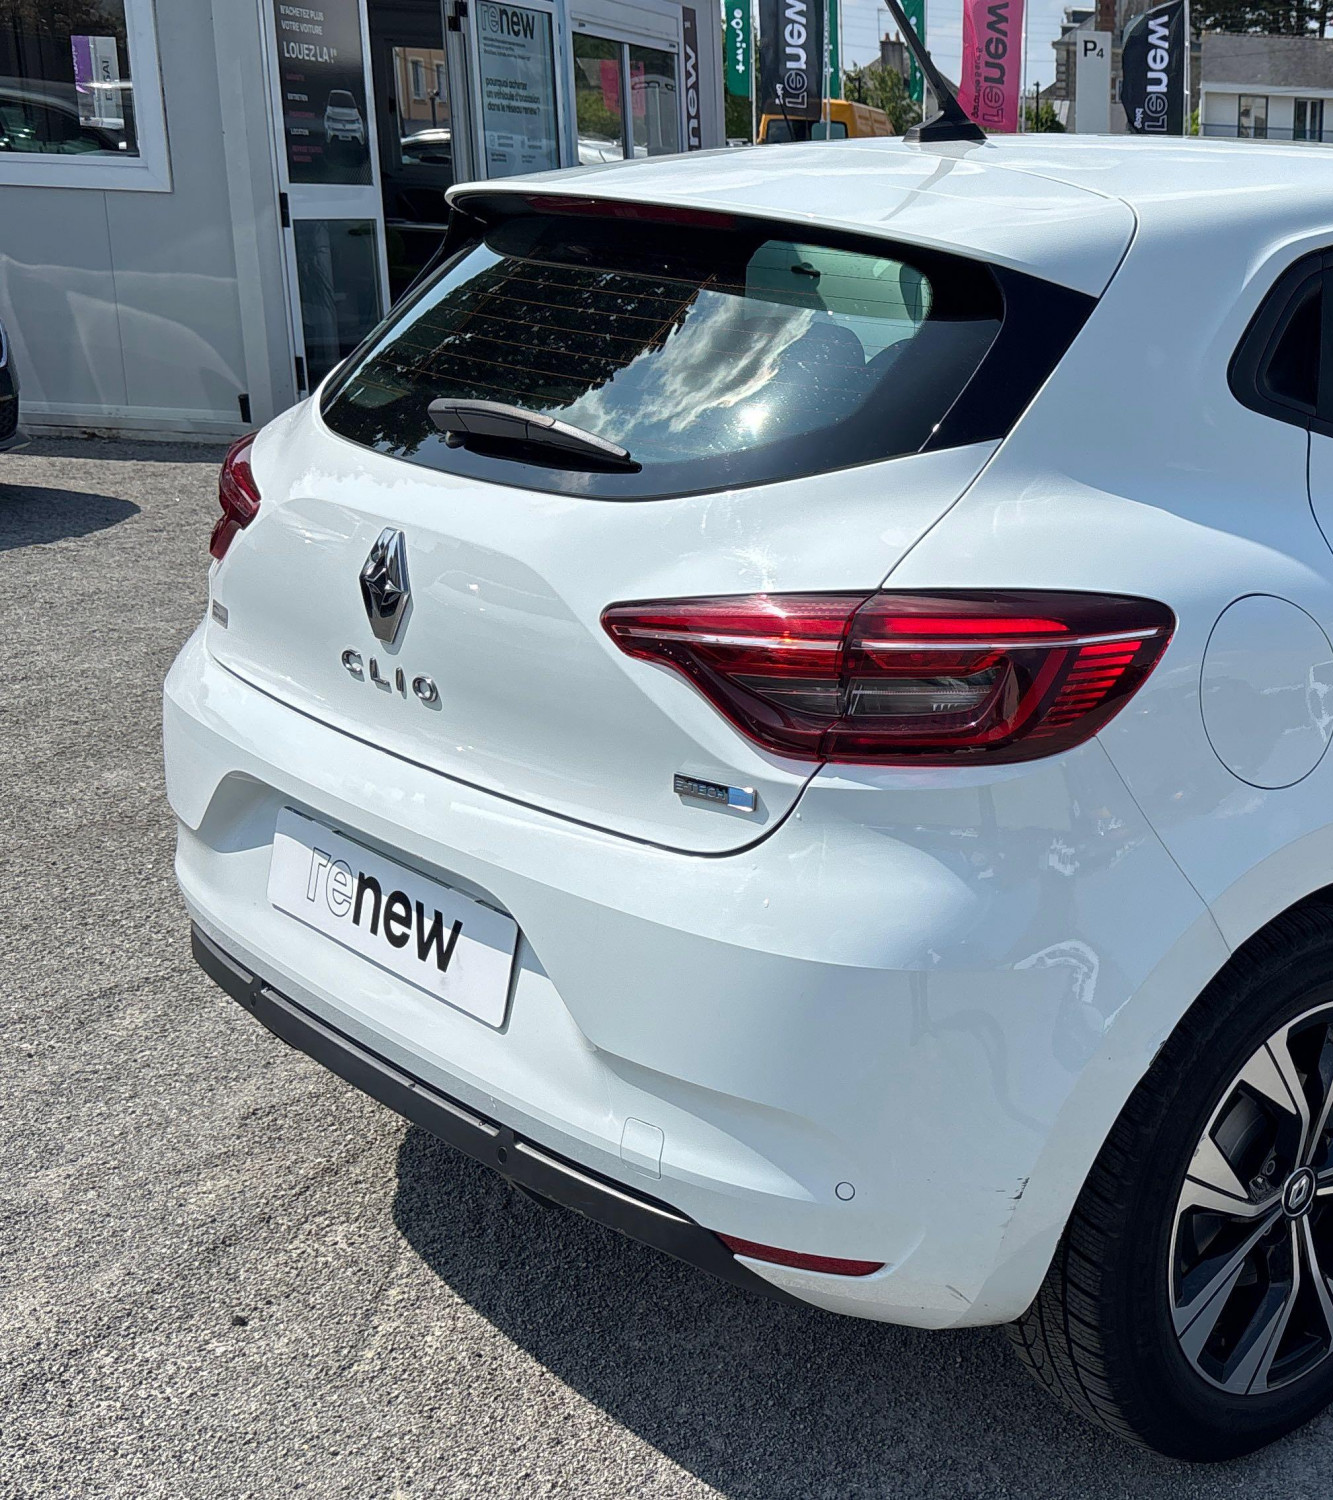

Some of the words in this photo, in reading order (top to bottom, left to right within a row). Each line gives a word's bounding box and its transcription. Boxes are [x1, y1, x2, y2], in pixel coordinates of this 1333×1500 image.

[281, 20, 300, 31] VOTRE
[300, 23, 323, 35] VOITURE
[481, 4, 535, 40] renew
[283, 41, 316, 61] LOUEZ
[1083, 40, 1104, 58] P4
[102, 60, 113, 101] ESAI
[684, 44, 700, 150] new
[341, 649, 438, 702] CLIO
[306, 846, 463, 973] renew
